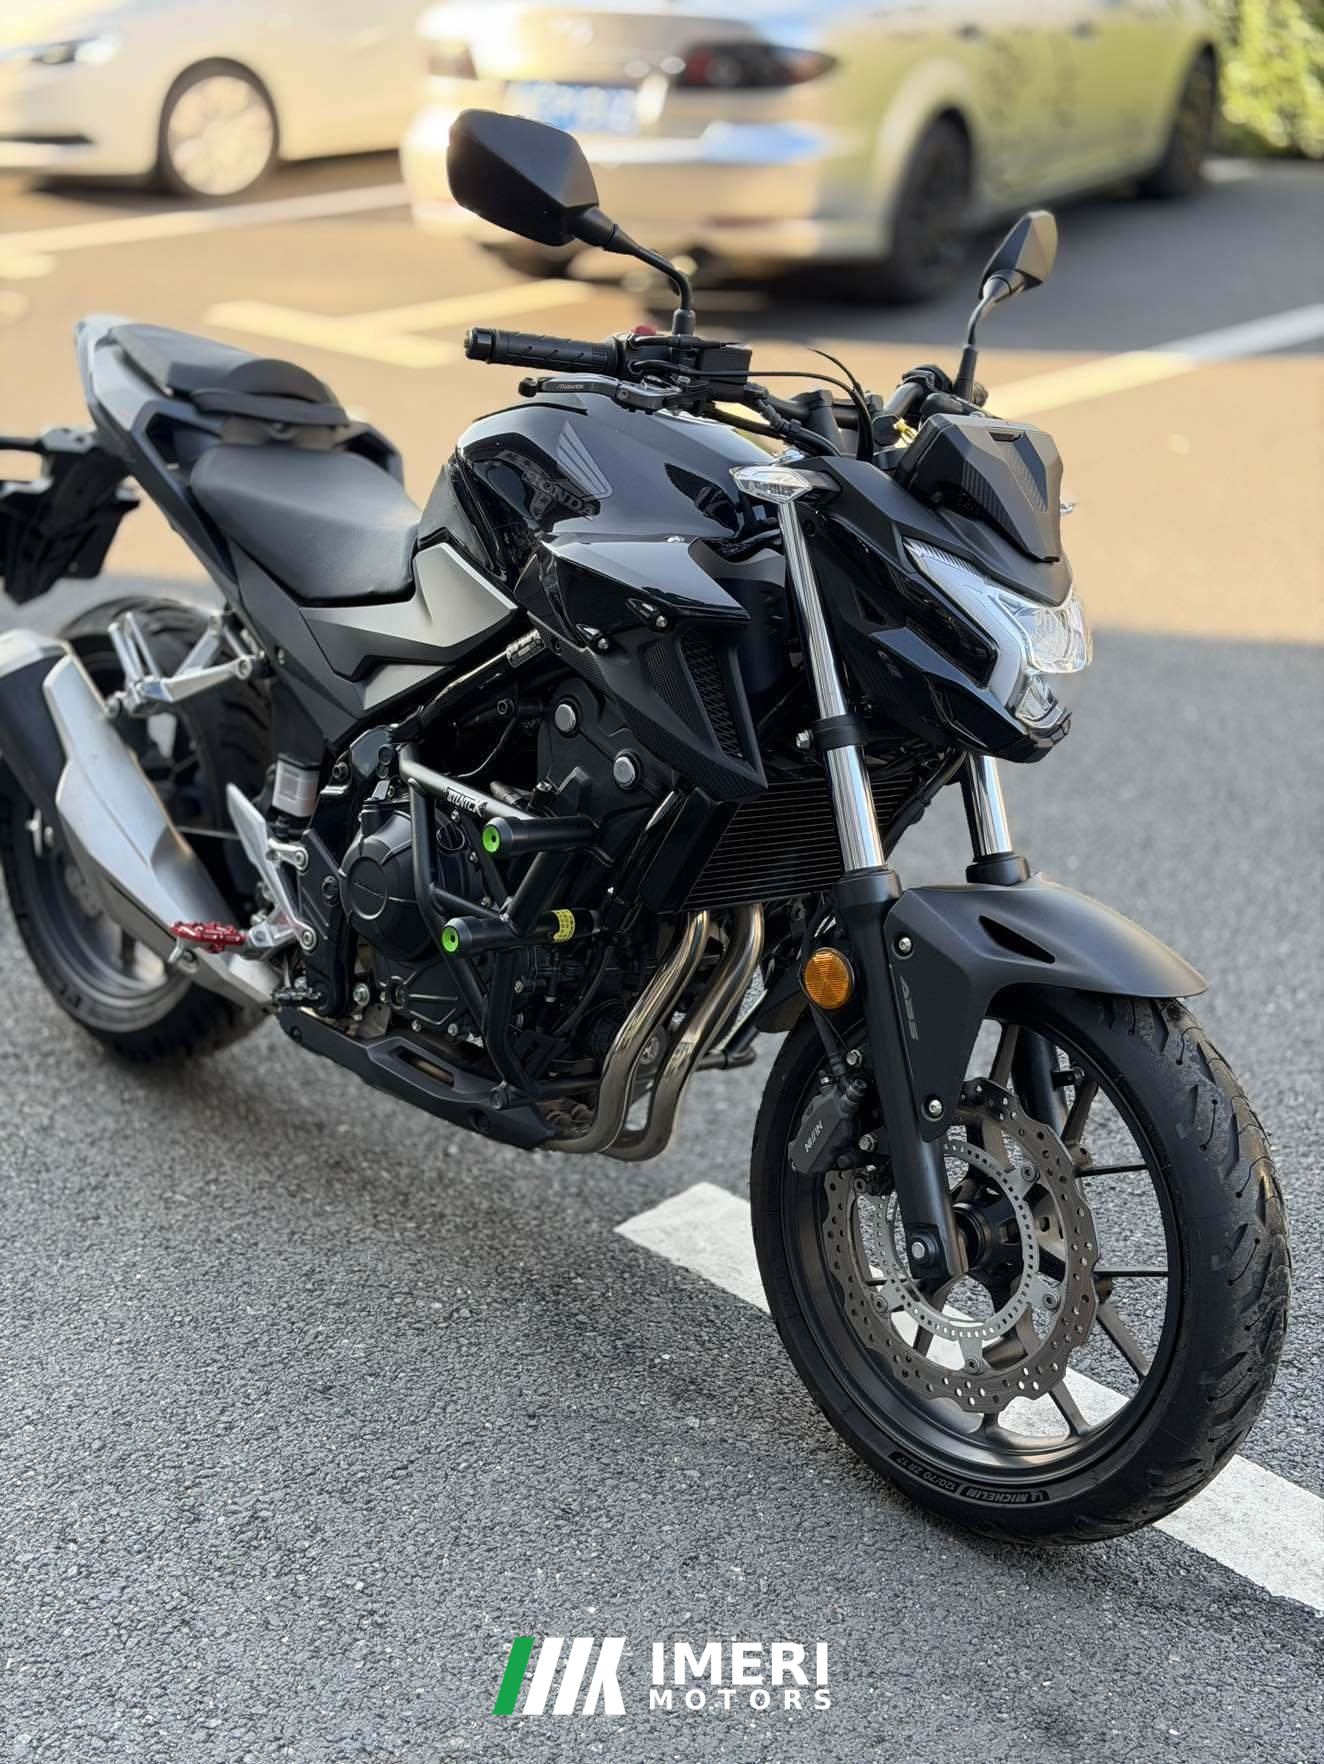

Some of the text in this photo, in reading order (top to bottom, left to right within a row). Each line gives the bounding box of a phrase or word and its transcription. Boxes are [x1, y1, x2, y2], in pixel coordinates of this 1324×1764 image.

[908, 1461, 921, 1474] ZR
[923, 1471, 957, 1491] 120/70
[966, 1487, 1029, 1504] MICHELIN
